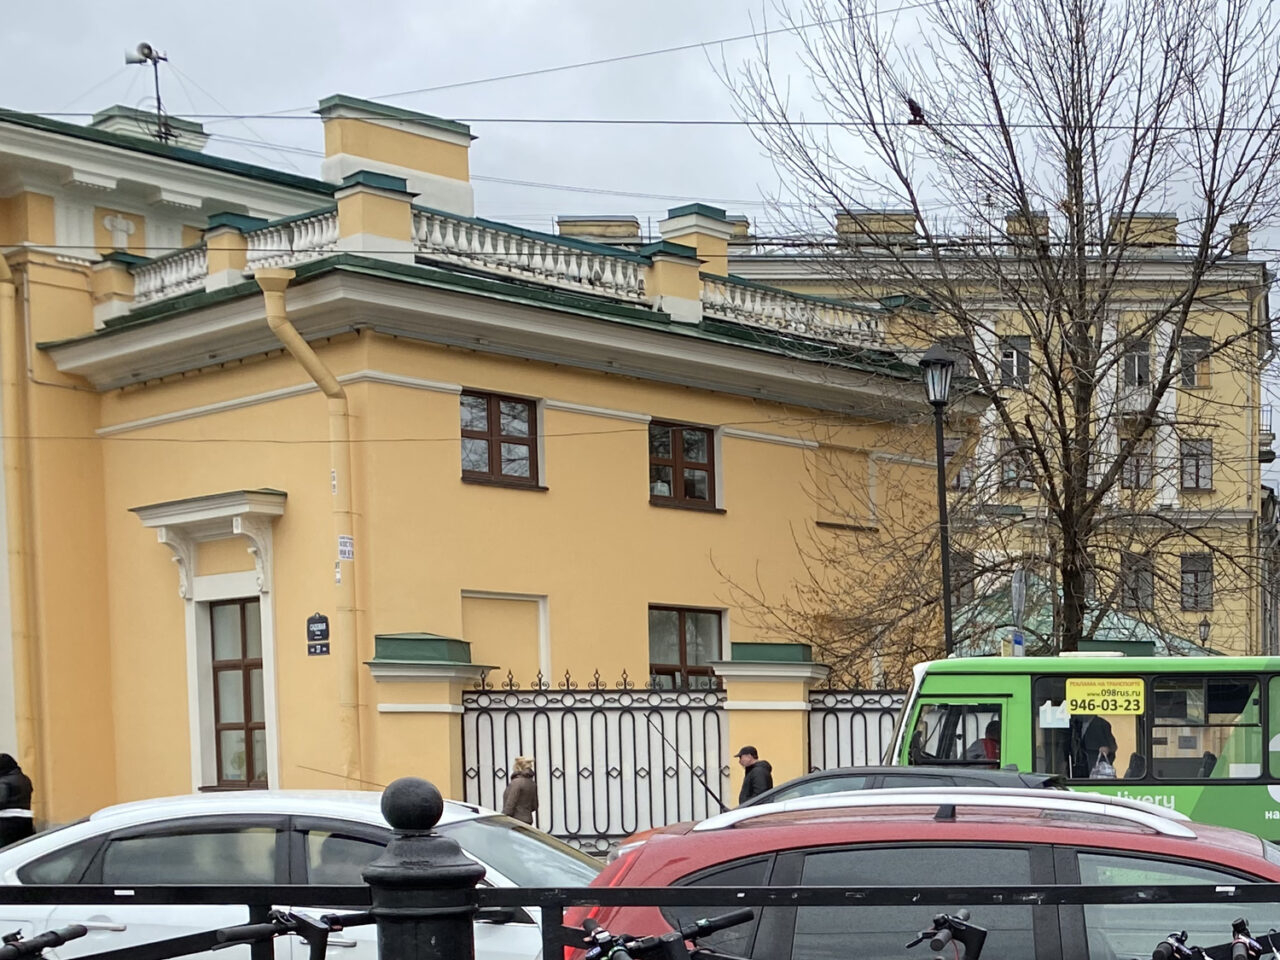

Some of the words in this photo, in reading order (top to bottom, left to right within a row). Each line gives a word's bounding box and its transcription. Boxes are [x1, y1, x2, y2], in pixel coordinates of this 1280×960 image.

[1087, 689, 1140, 697] www.098rus.ru
[1070, 699, 1140, 711] 946-03-23
[1265, 811, 1280, 819] на
